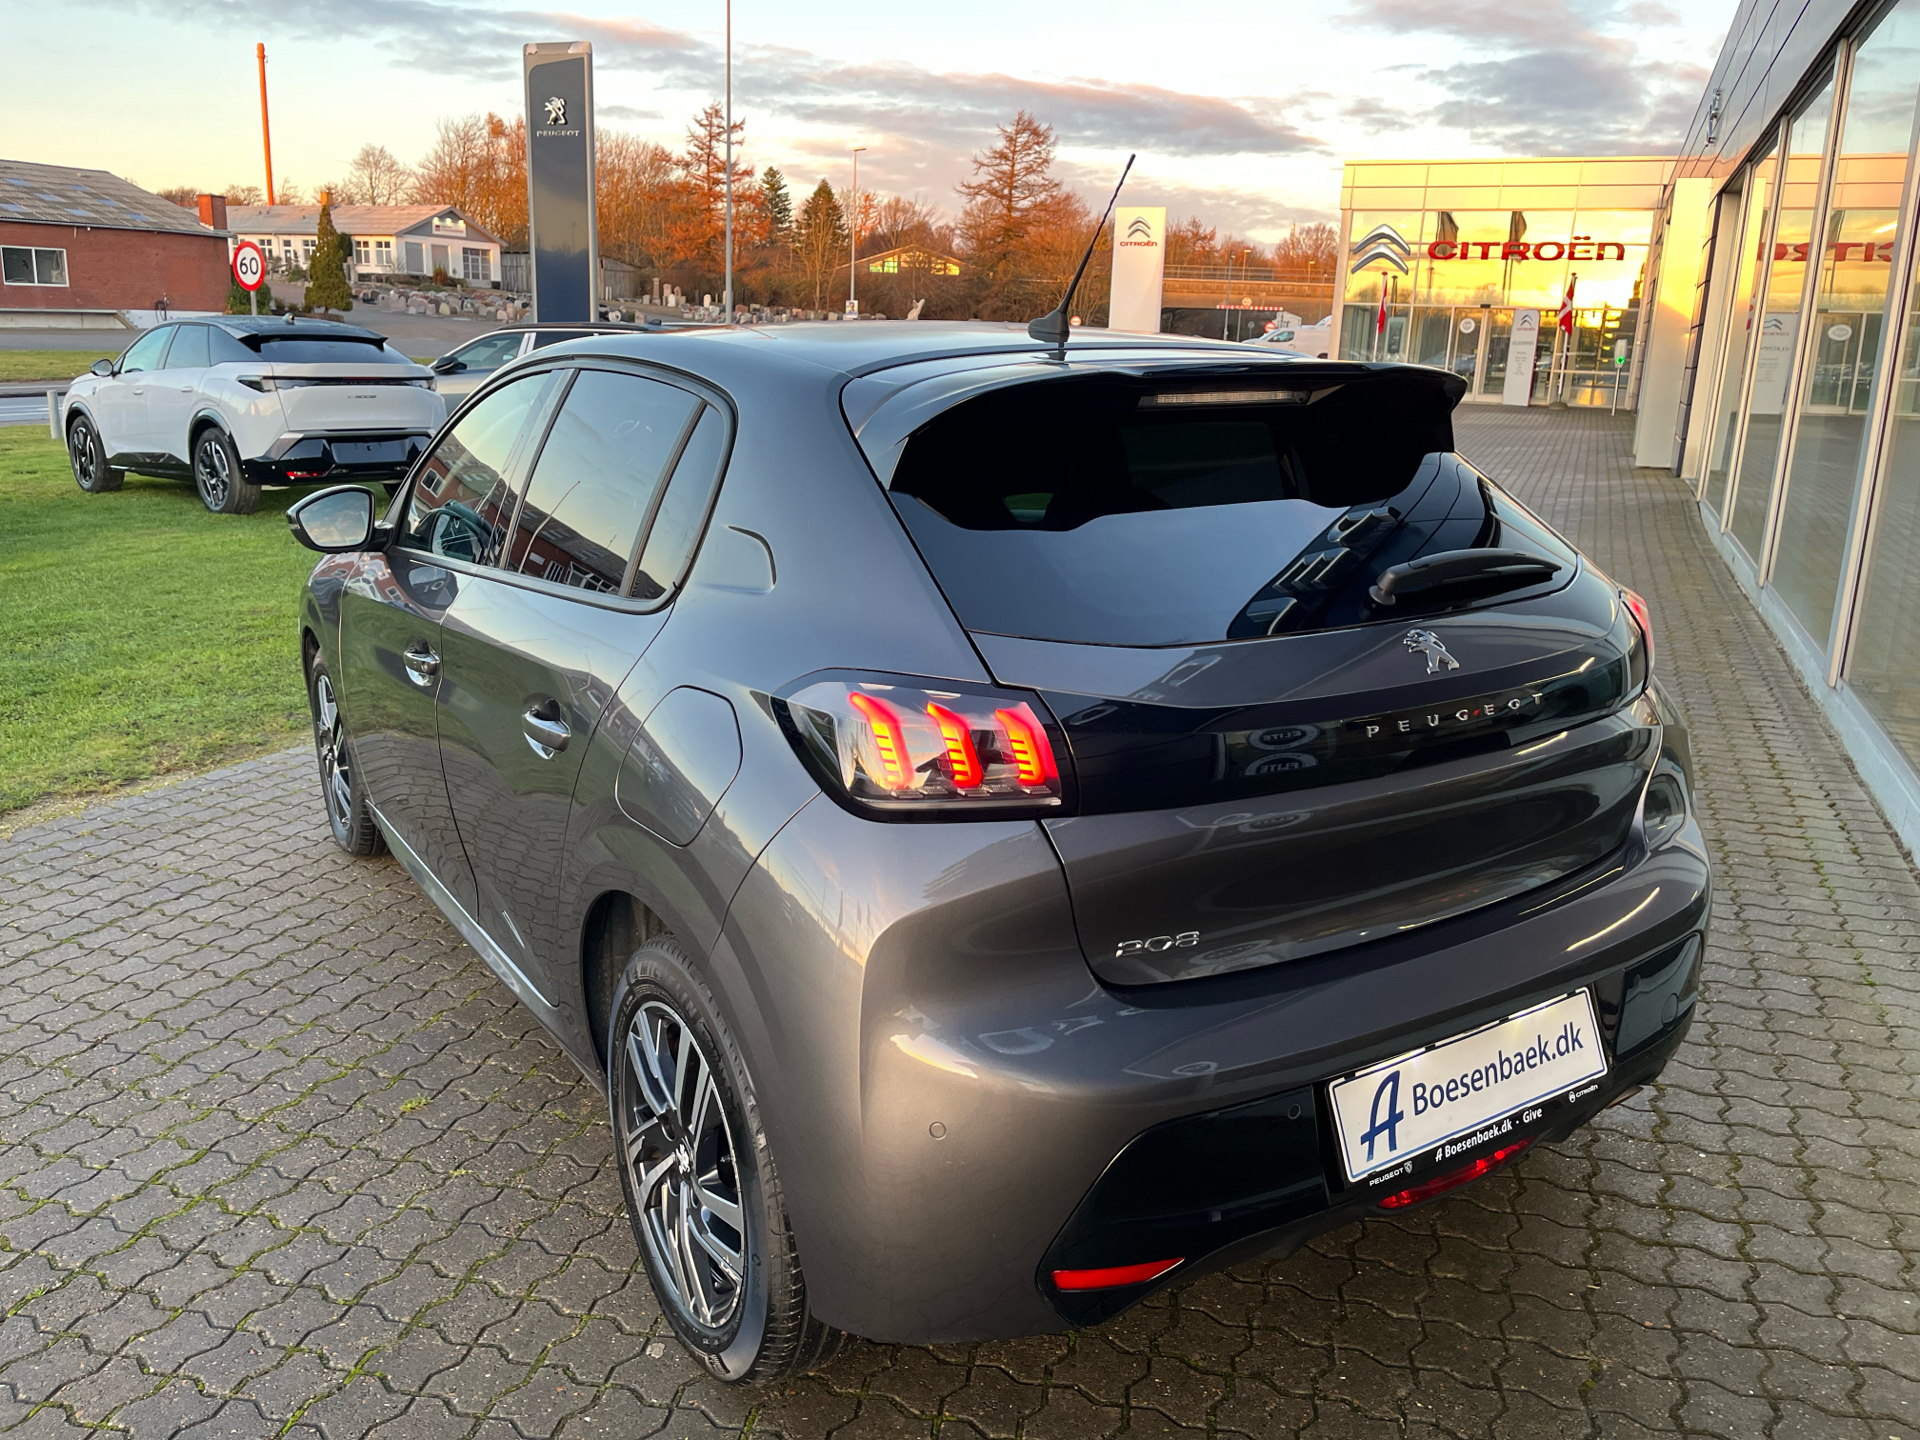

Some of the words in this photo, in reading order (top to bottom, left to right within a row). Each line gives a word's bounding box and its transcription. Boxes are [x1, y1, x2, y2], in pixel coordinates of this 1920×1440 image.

[240, 256, 259, 275] 60
[1366, 692, 1543, 738] PEUGEOT
[1412, 1021, 1584, 1116] Boesenbaek.dk
[1445, 1119, 1513, 1158] Boesenbaek.dk
[1523, 1107, 1543, 1124] Give
[1369, 1167, 1404, 1187] PEUGEOT
